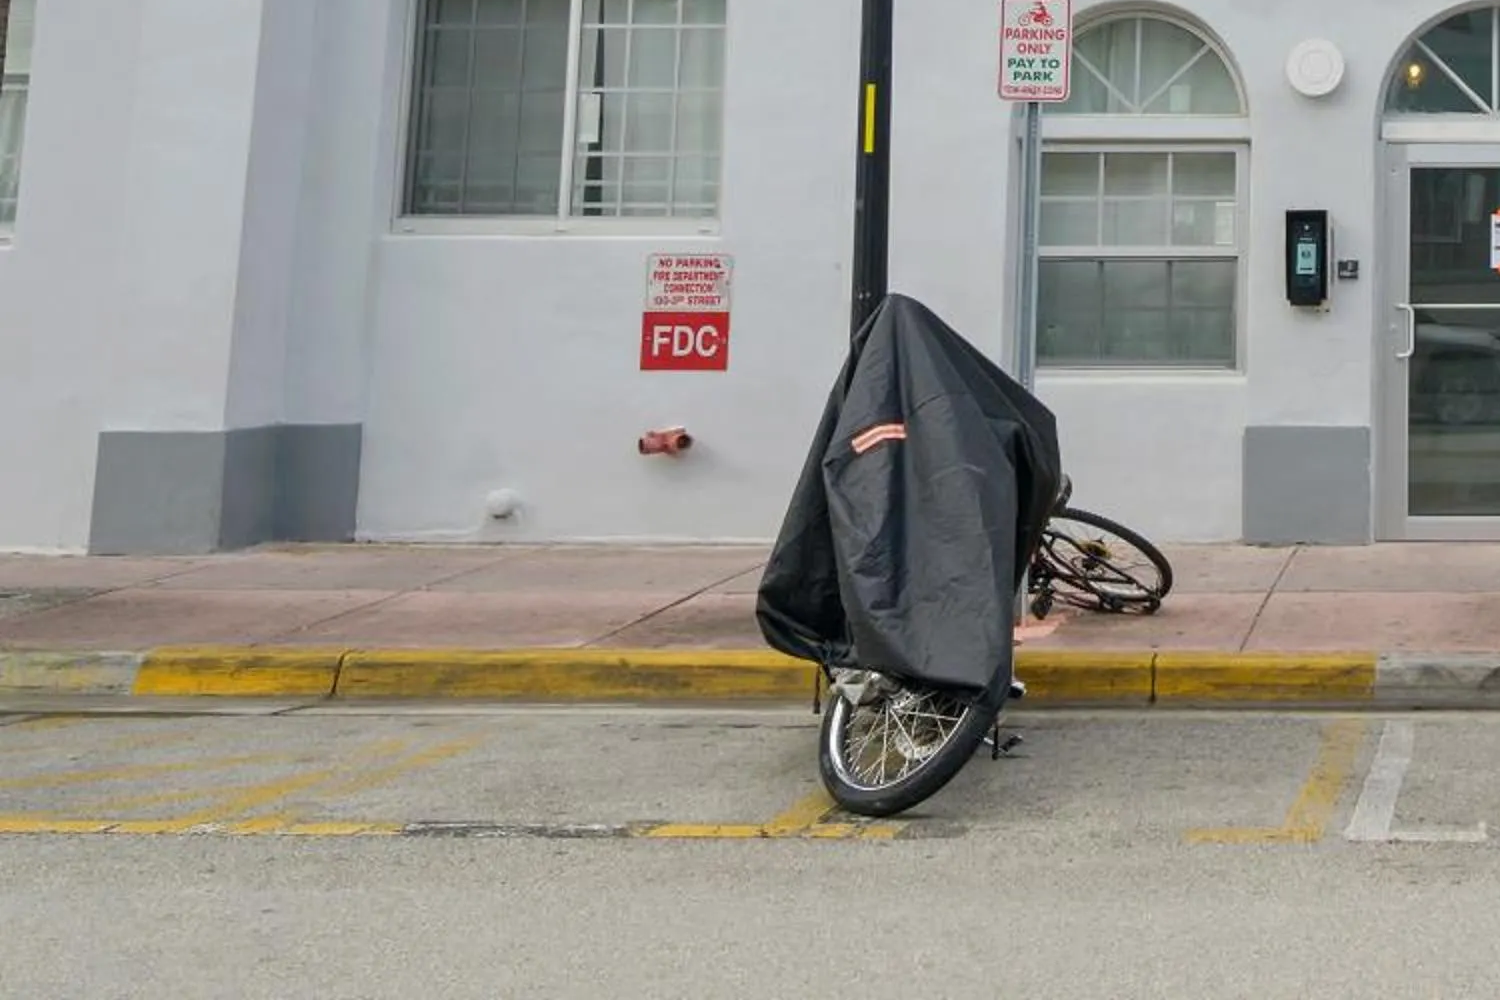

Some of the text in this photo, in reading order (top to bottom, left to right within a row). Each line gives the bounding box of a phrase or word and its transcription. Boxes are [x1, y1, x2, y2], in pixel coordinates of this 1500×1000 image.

[1005, 28, 1065, 41] PARKING
[1016, 43, 1053, 55] ONLY
[1008, 58, 1060, 69] PAY TO
[1013, 71, 1054, 81] PARK
[658, 258, 721, 269] NO PARKING
[652, 325, 718, 357] FDC
